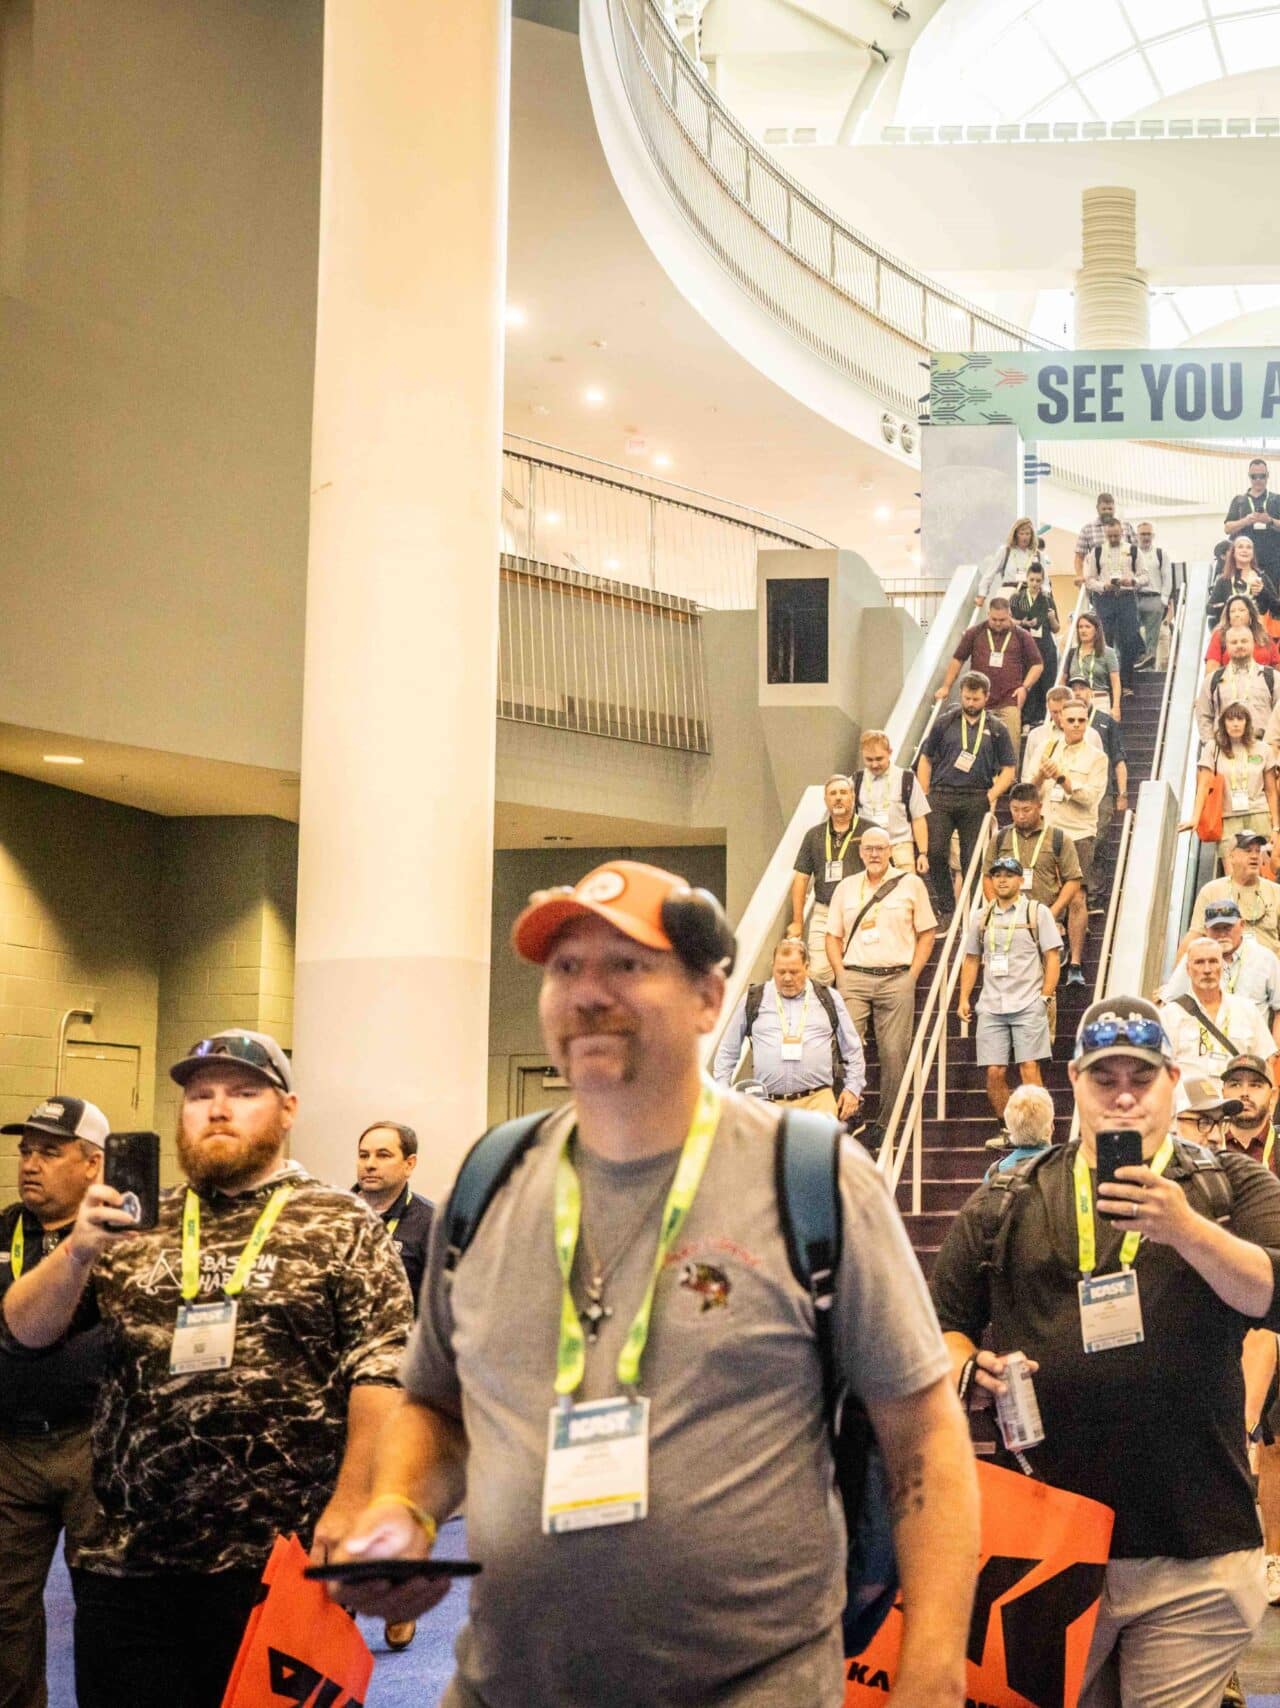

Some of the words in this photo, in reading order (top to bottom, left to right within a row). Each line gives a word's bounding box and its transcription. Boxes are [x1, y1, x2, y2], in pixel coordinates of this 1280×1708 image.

[1037, 363, 1125, 425] SEE
[1140, 361, 1244, 422] YOU
[200, 1255, 278, 1273] BASIN
[199, 1270, 274, 1293] HABTS
